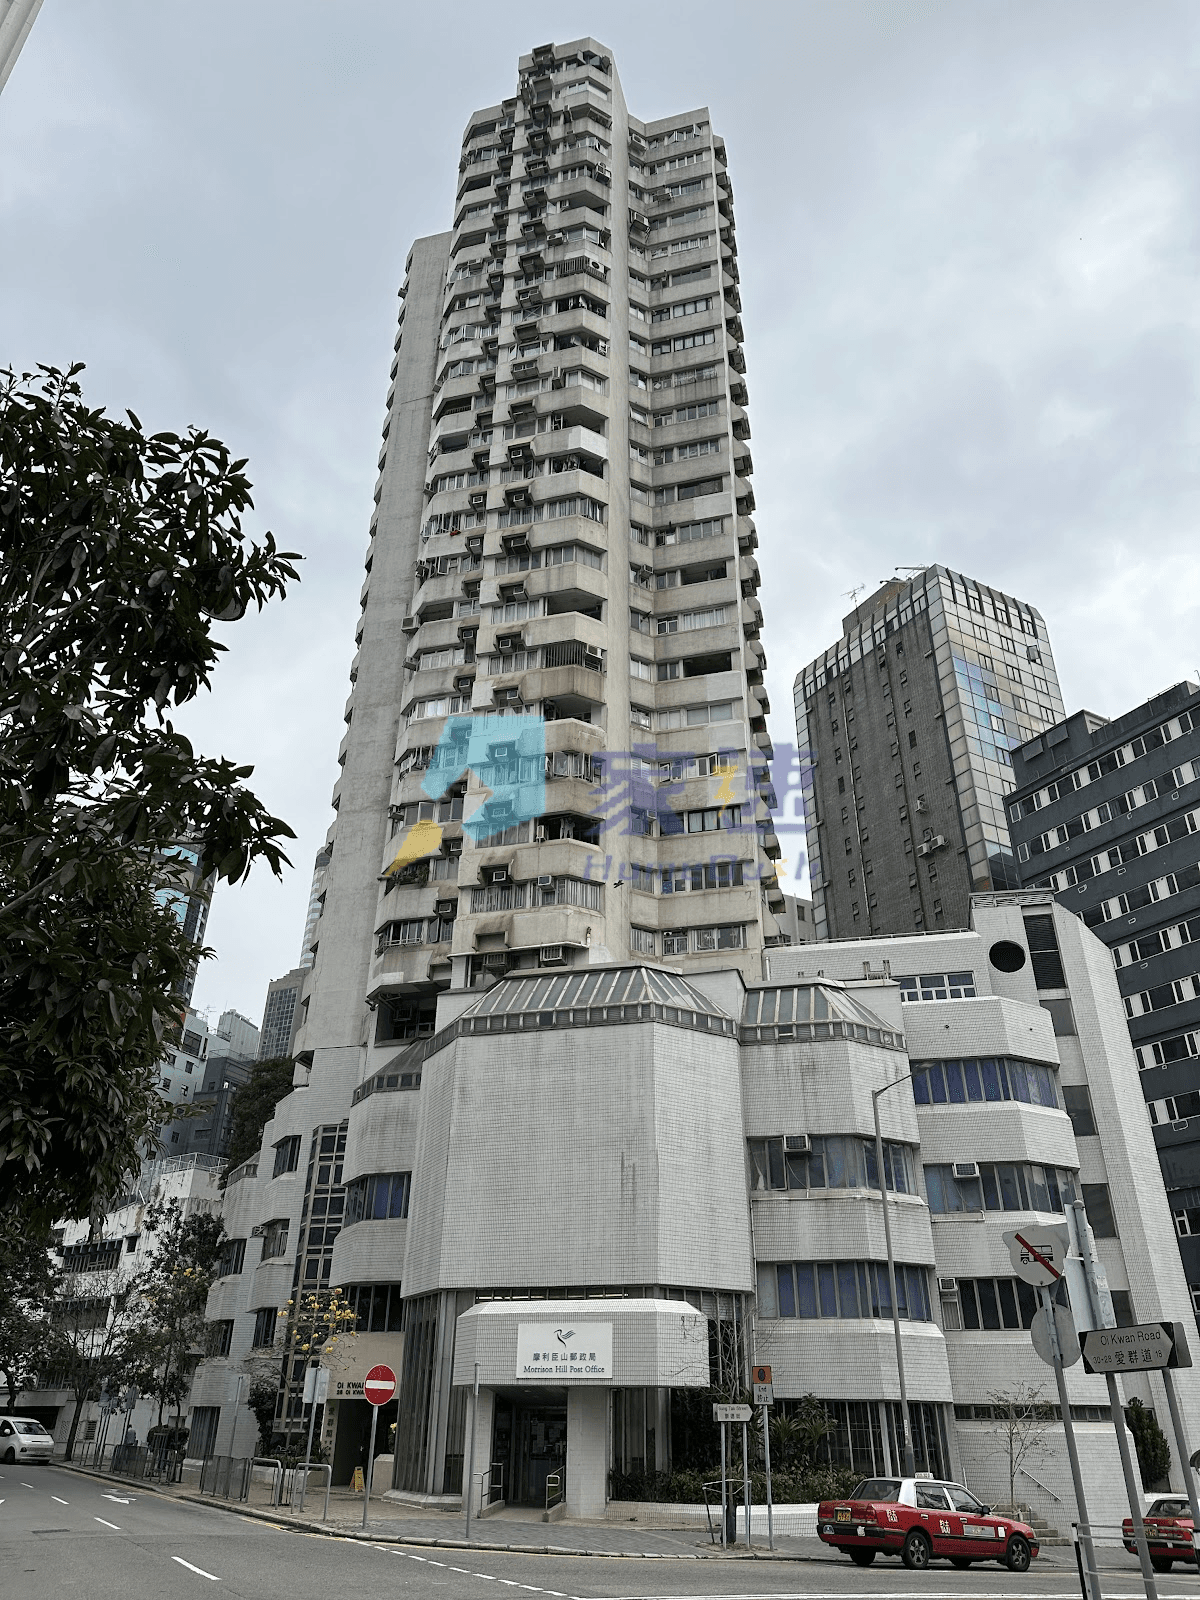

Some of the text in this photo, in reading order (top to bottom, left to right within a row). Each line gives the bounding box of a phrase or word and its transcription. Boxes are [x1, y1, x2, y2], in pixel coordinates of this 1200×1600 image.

[1100, 1330, 1161, 1346] Oi Kwan Road
[532, 1352, 597, 1362] 摩利臣山郵政局
[1114, 1348, 1153, 1366] 愛群道
[1155, 1349, 1163, 1358] 18
[555, 1365, 568, 1373] Hill
[585, 1365, 605, 1373] Office
